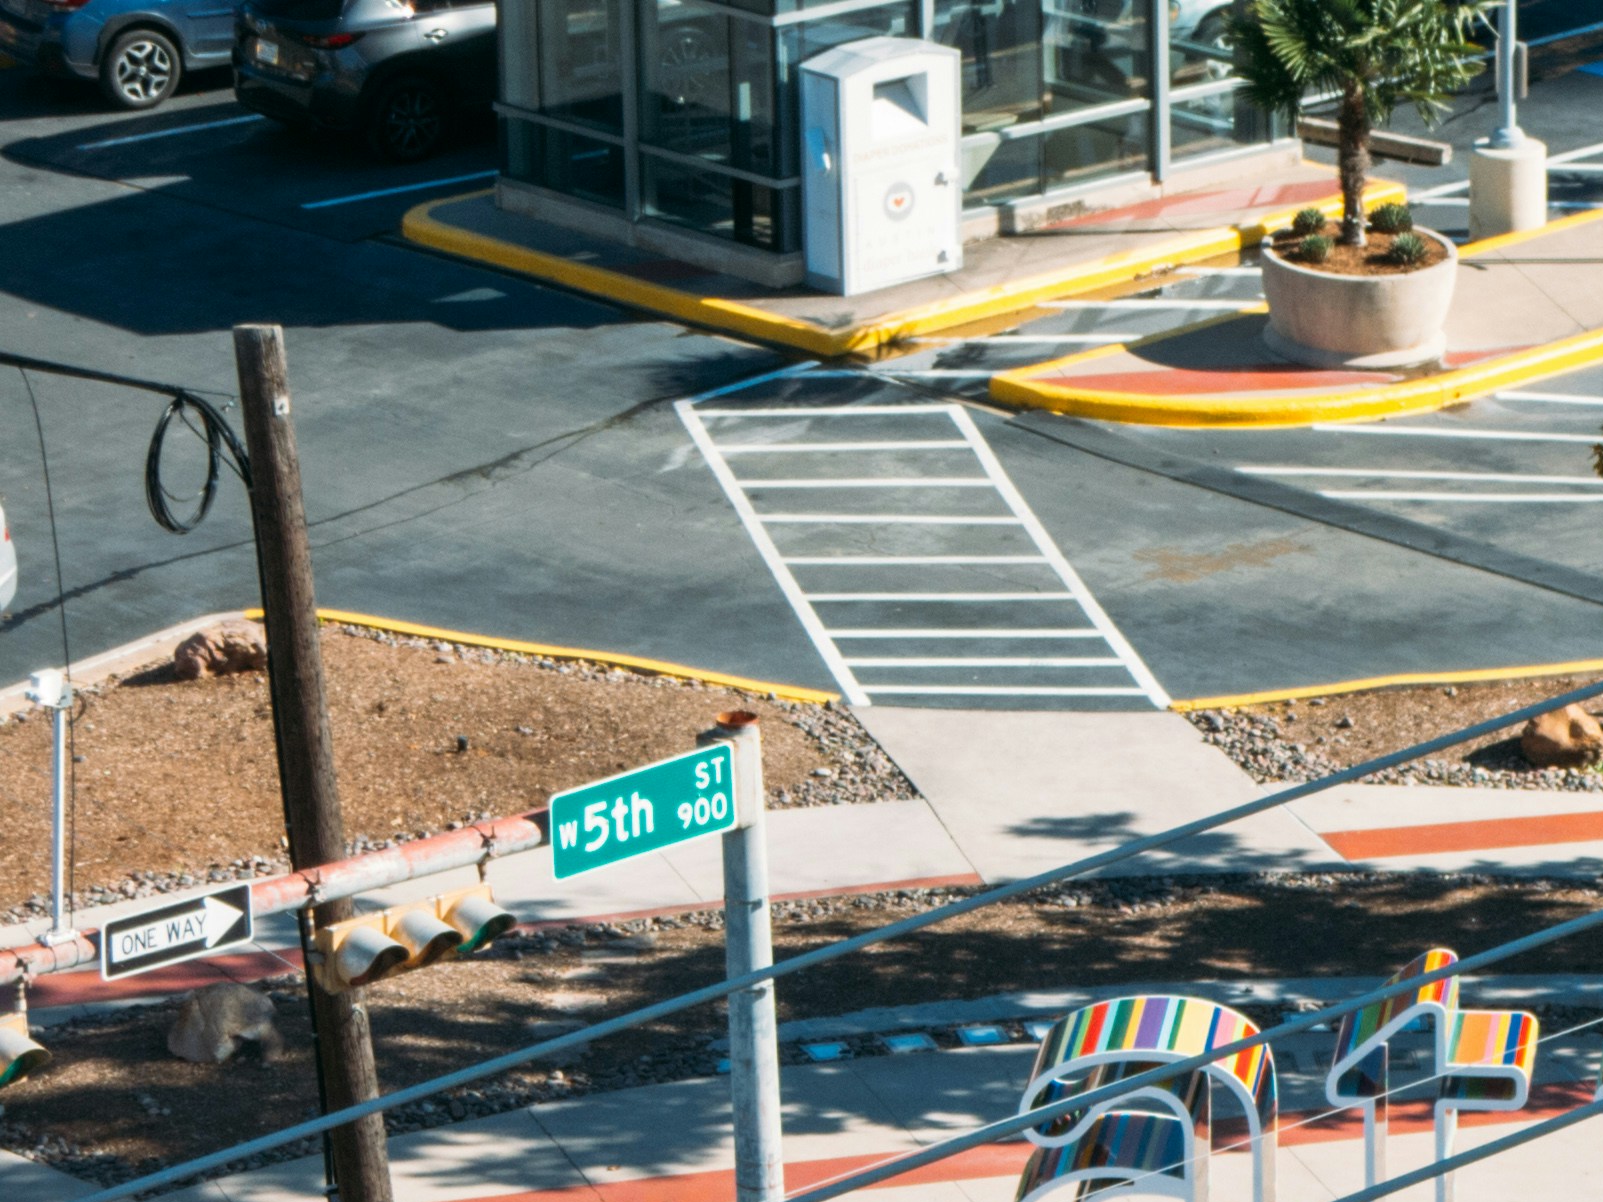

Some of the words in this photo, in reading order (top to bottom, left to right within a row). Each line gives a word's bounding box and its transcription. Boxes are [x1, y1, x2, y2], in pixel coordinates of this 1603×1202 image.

[695, 756, 725, 789] ST
[559, 820, 578, 850] W
[584, 791, 654, 852] 5th
[677, 792, 728, 830] 900
[122, 927, 157, 955] ONE
[166, 914, 207, 943] WAY
